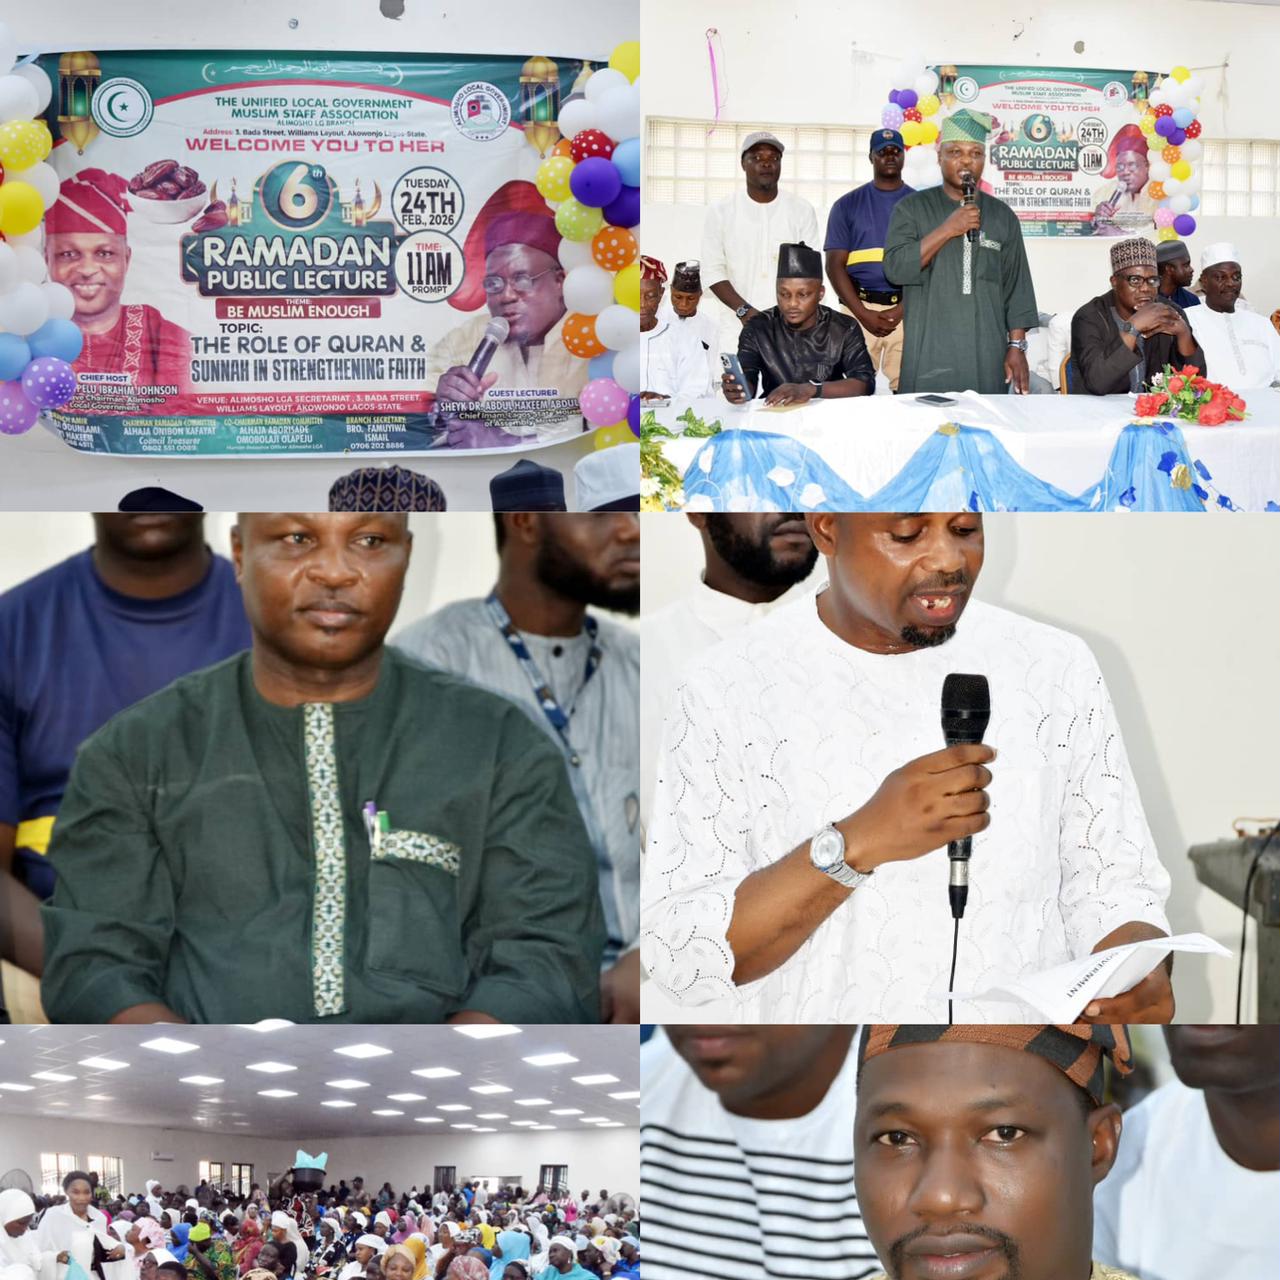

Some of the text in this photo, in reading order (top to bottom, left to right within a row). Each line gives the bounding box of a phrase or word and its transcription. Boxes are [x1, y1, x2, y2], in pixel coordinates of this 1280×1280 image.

[215, 97, 413, 109] THE UNIFIED LOCAL GOVERNMENT
[231, 109, 399, 120] MUSLIM STAFF ASSOCIATION
[1031, 115, 1048, 140] 6
[347, 130, 383, 138] Akowonjo
[1081, 128, 1105, 138] 24TH
[185, 138, 445, 153] WELCOME YOU TO HER
[999, 145, 1077, 160] RAMADAN
[1000, 159, 1076, 169] PUBLIC LECTURE
[1083, 153, 1102, 168] 11AM
[404, 178, 450, 189] TUESDAY
[279, 164, 323, 220] 6 th
[994, 187, 1091, 196] THE ROLE OF QURAN &
[400, 191, 456, 214] 24TH
[1027, 197, 1091, 207] STRENGTHENING FAITH
[429, 214, 454, 226] 2026
[203, 235, 392, 267] RAMADAN
[416, 243, 442, 252] TIME:
[407, 251, 451, 286] 11AM
[207, 270, 387, 290] PUBLIC LECTURE
[412, 286, 448, 294] PROMPT
[227, 305, 370, 318] BE MUSLIM ENOUGH
[220, 323, 263, 334] TOPIC:
[191, 335, 426, 354] THE ROLE OF QURAN &
[192, 358, 426, 383] SUNNAH IN STRENGTHENING FAITH
[100, 385, 178, 395] IBRAHIM JOHNSON
[489, 390, 514, 398] GUEST
[128, 396, 166, 404] Alimosho
[197, 397, 228, 405] VENUE:
[230, 396, 274, 404] ALIMOSHO
[295, 395, 350, 403] SECRETARIAT
[217, 403, 346, 413] WILLIAMS AKOWONJO
[441, 400, 548, 412] SHEYK DR. ABDUL HAKEEM
[124, 427, 151, 435] ALHAJA
[268, 426, 309, 435] ABORISADE
[347, 424, 407, 433] BRO. FAMUYIWA
[139, 437, 201, 445] Council Treasurer
[236, 435, 313, 444] OMOBOLAJI OLAPEJU
[365, 434, 389, 442] ISMAIL
